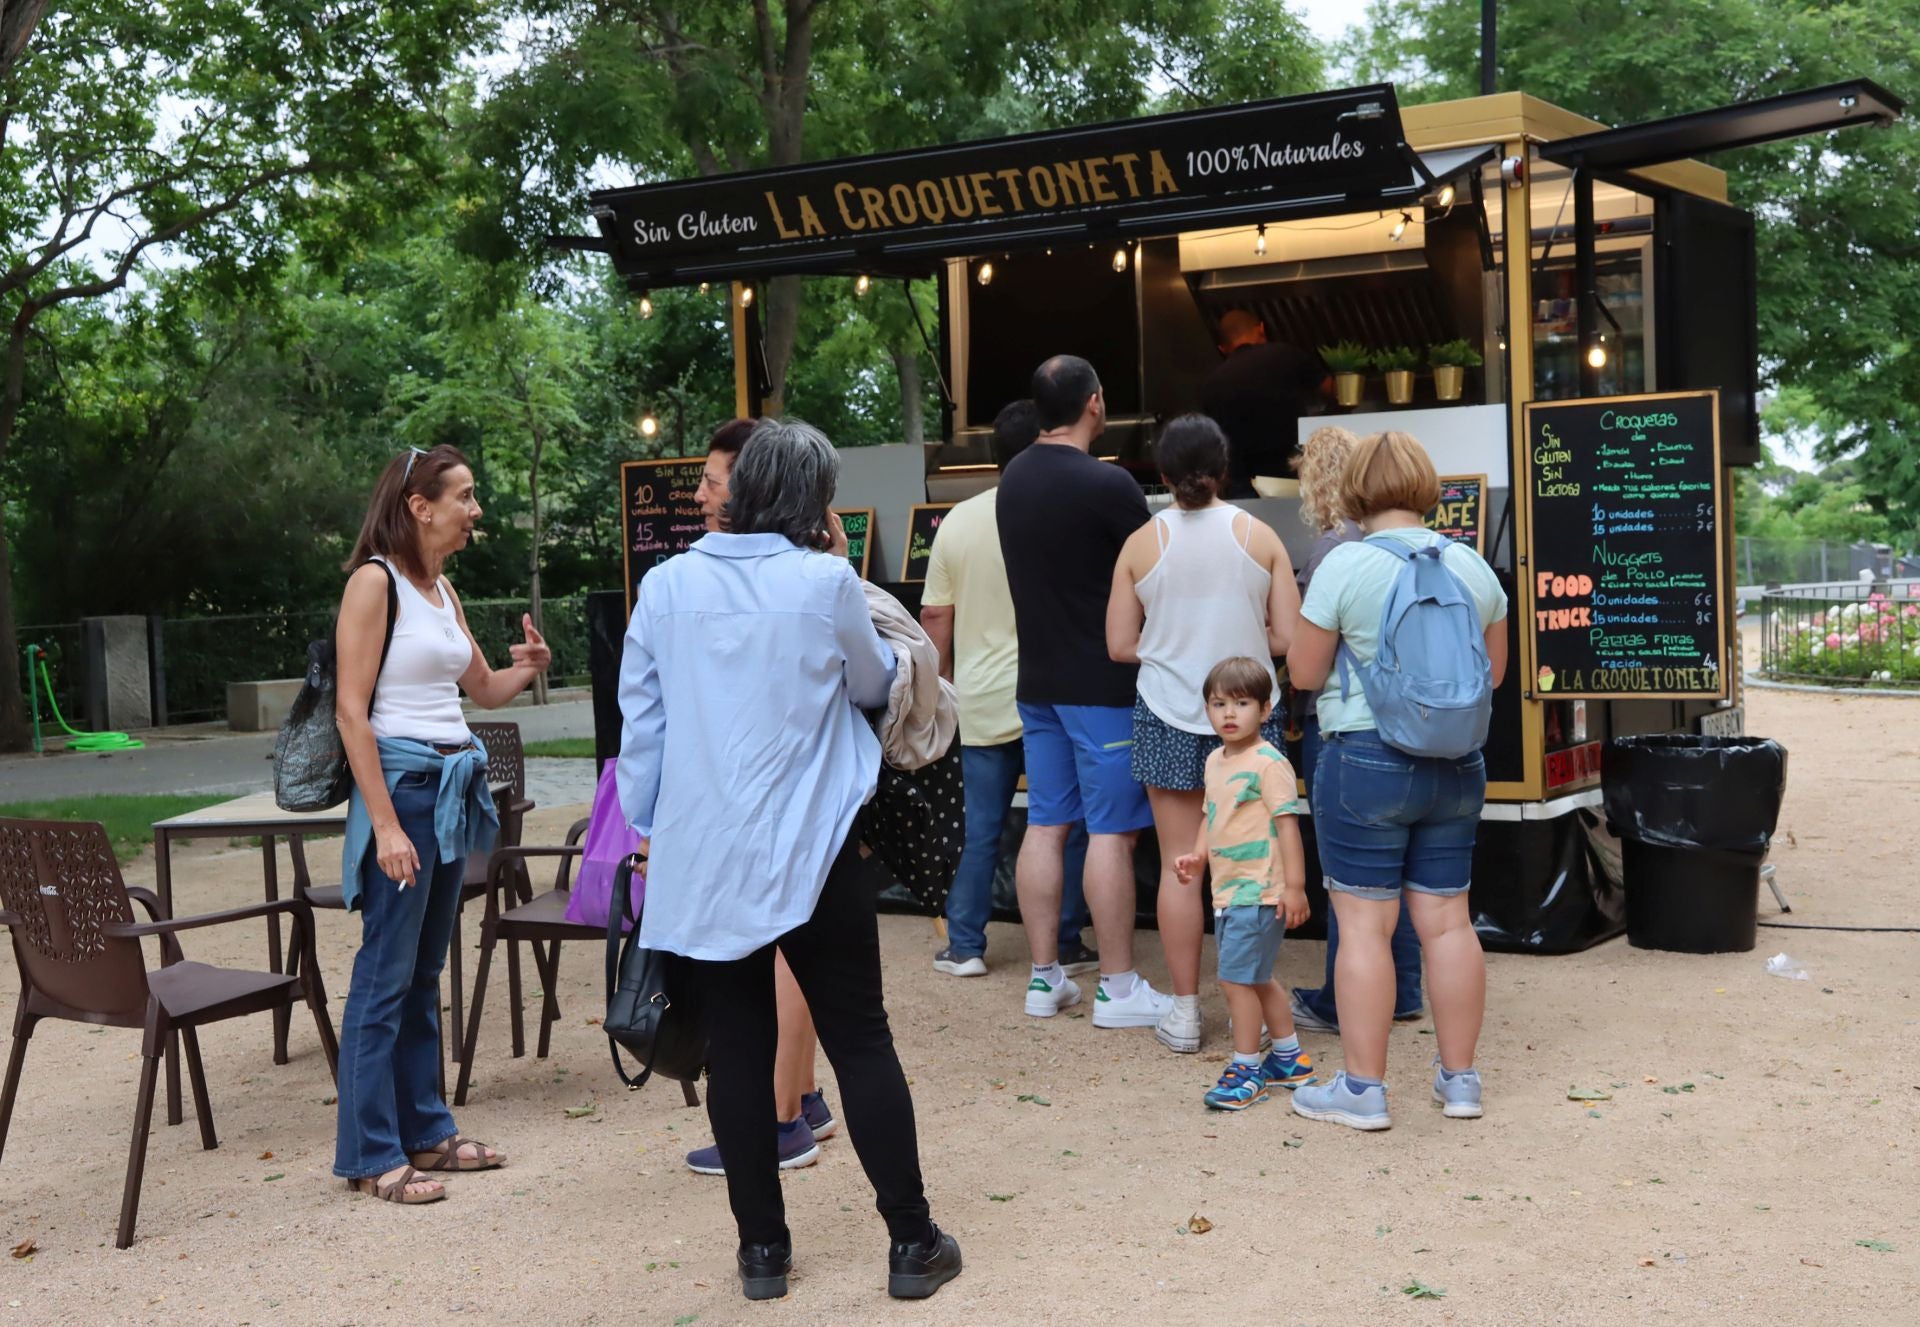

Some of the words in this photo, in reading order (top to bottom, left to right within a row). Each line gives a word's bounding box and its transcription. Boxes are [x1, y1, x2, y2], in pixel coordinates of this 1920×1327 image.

[764, 191, 826, 239] LA
[833, 150, 1179, 230] CROQUETONETA
[634, 219, 670, 246] Sin
[677, 210, 759, 240] Gluten
[634, 484, 654, 505] 10
[1592, 502, 1606, 521] 10
[1608, 509, 1655, 519] unidades
[637, 522, 654, 541] 15
[1592, 523, 1606, 536] 15
[1609, 522, 1655, 534] unidades
[1591, 589, 1607, 606] 10
[1607, 594, 1659, 606] unidades
[1536, 607, 1592, 632] TRUCK
[1591, 610, 1606, 625] 15
[1607, 612, 1658, 624] unidades
[1560, 669, 1584, 691] LA
[1590, 667, 1720, 691] CROQUETONETA
